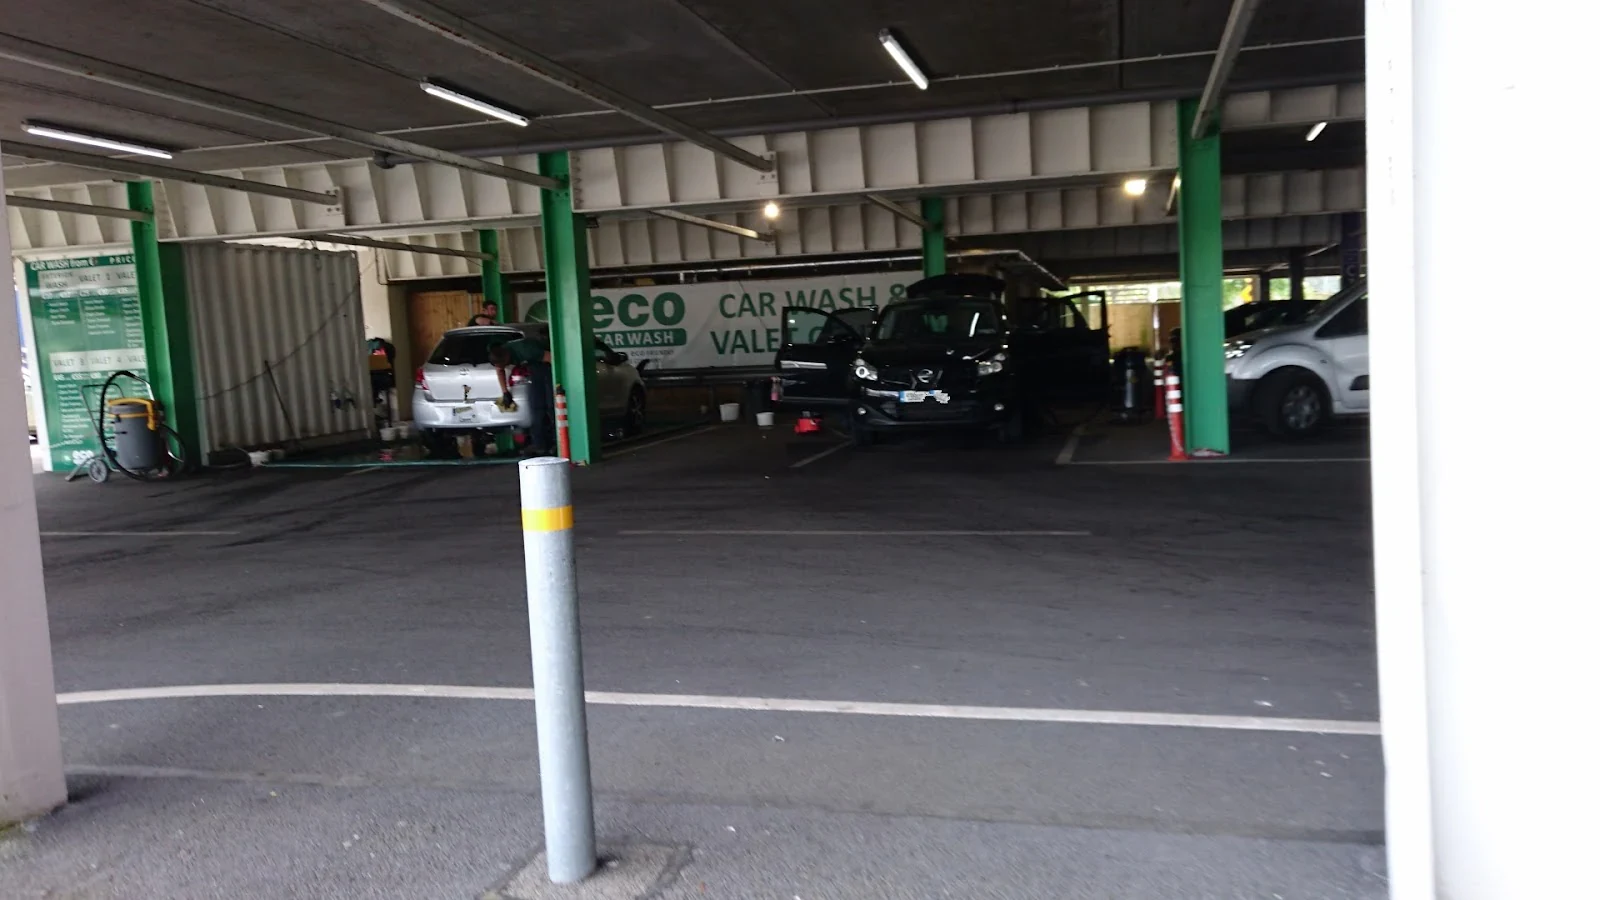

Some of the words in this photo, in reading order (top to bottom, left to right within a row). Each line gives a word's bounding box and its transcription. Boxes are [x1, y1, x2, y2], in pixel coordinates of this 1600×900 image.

[31, 261, 46, 271] CAR
[46, 259, 70, 269] WASH
[116, 271, 136, 280] VALE
[718, 291, 777, 319] CAR
[785, 285, 877, 316] WASH
[591, 292, 686, 329] eco
[626, 330, 675, 346] WASH
